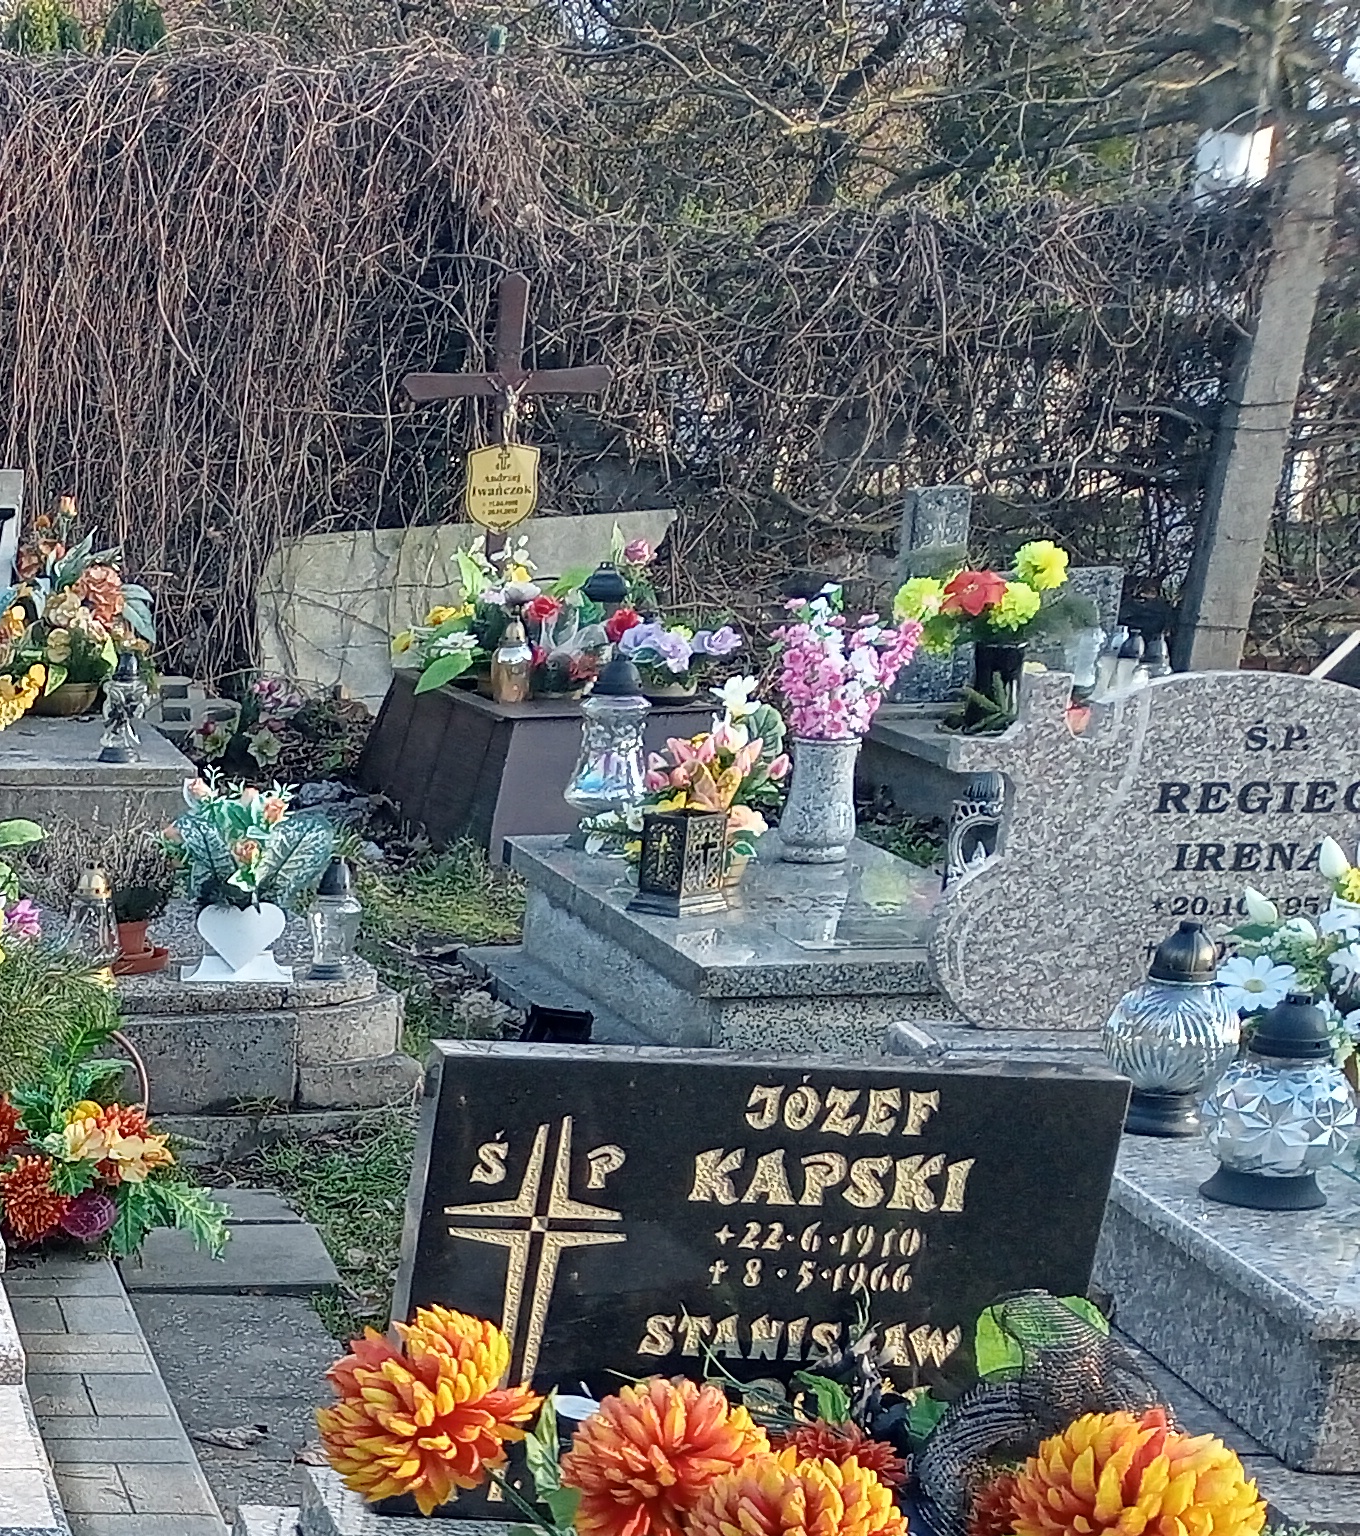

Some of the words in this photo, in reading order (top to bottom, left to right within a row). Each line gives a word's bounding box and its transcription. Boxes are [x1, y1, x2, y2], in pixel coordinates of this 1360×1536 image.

[471, 483, 532, 498] Iwańczok
[1171, 842, 1322, 872] IRENA
[744, 1073, 941, 1137] JÓZEF
[468, 1129, 511, 1186] Ś
[585, 1143, 627, 1191] P
[686, 1146, 977, 1214] KAPSKI
[635, 1311, 963, 1369] STANISAW
